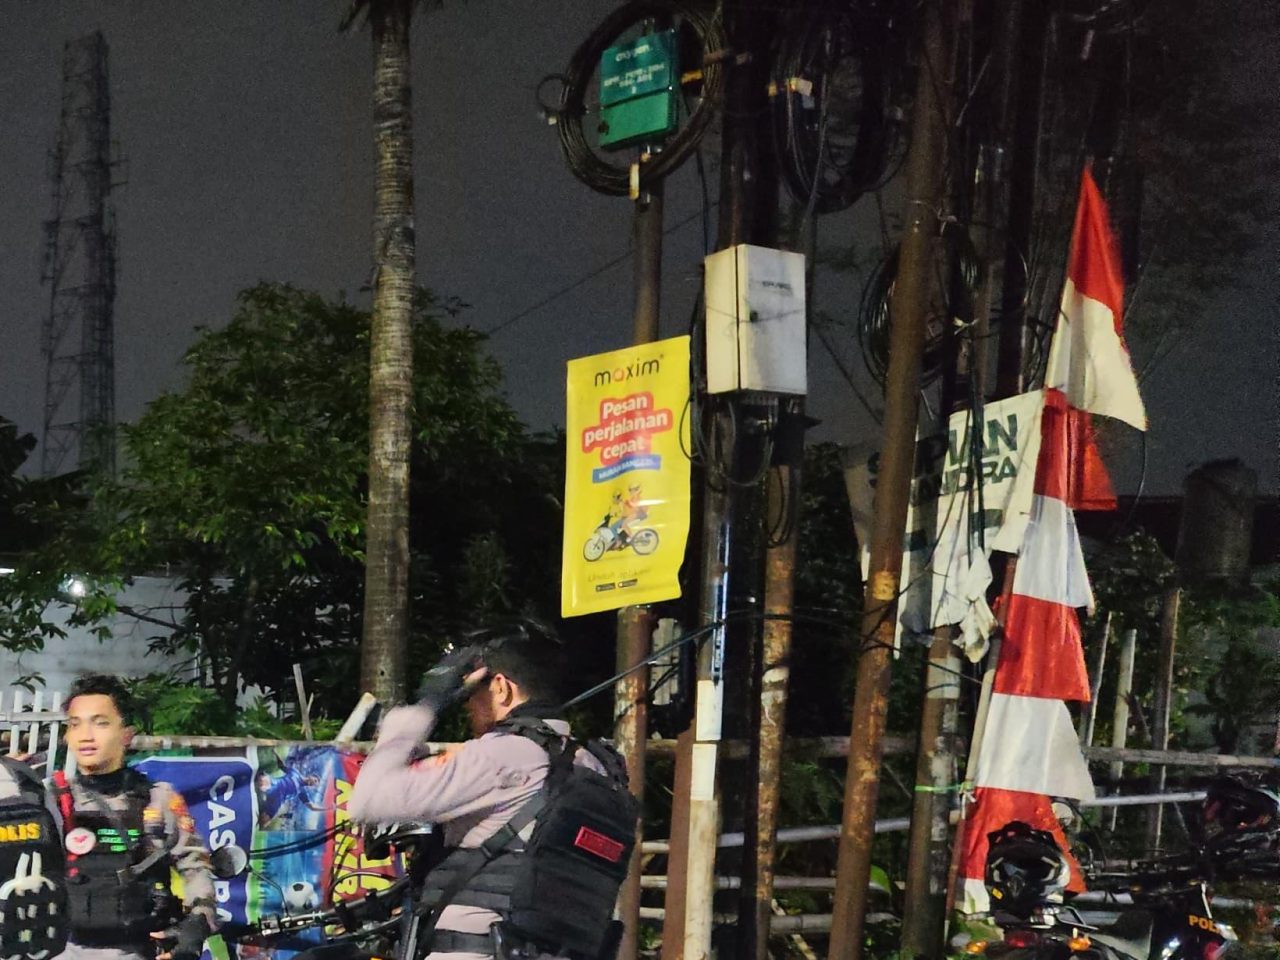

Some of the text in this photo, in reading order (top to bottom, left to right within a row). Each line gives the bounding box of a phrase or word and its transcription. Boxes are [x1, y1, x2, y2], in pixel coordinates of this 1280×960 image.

[594, 358, 660, 388] maxim
[602, 396, 648, 420] Pesan
[584, 411, 669, 448] perjalanan
[602, 436, 646, 460] cepat
